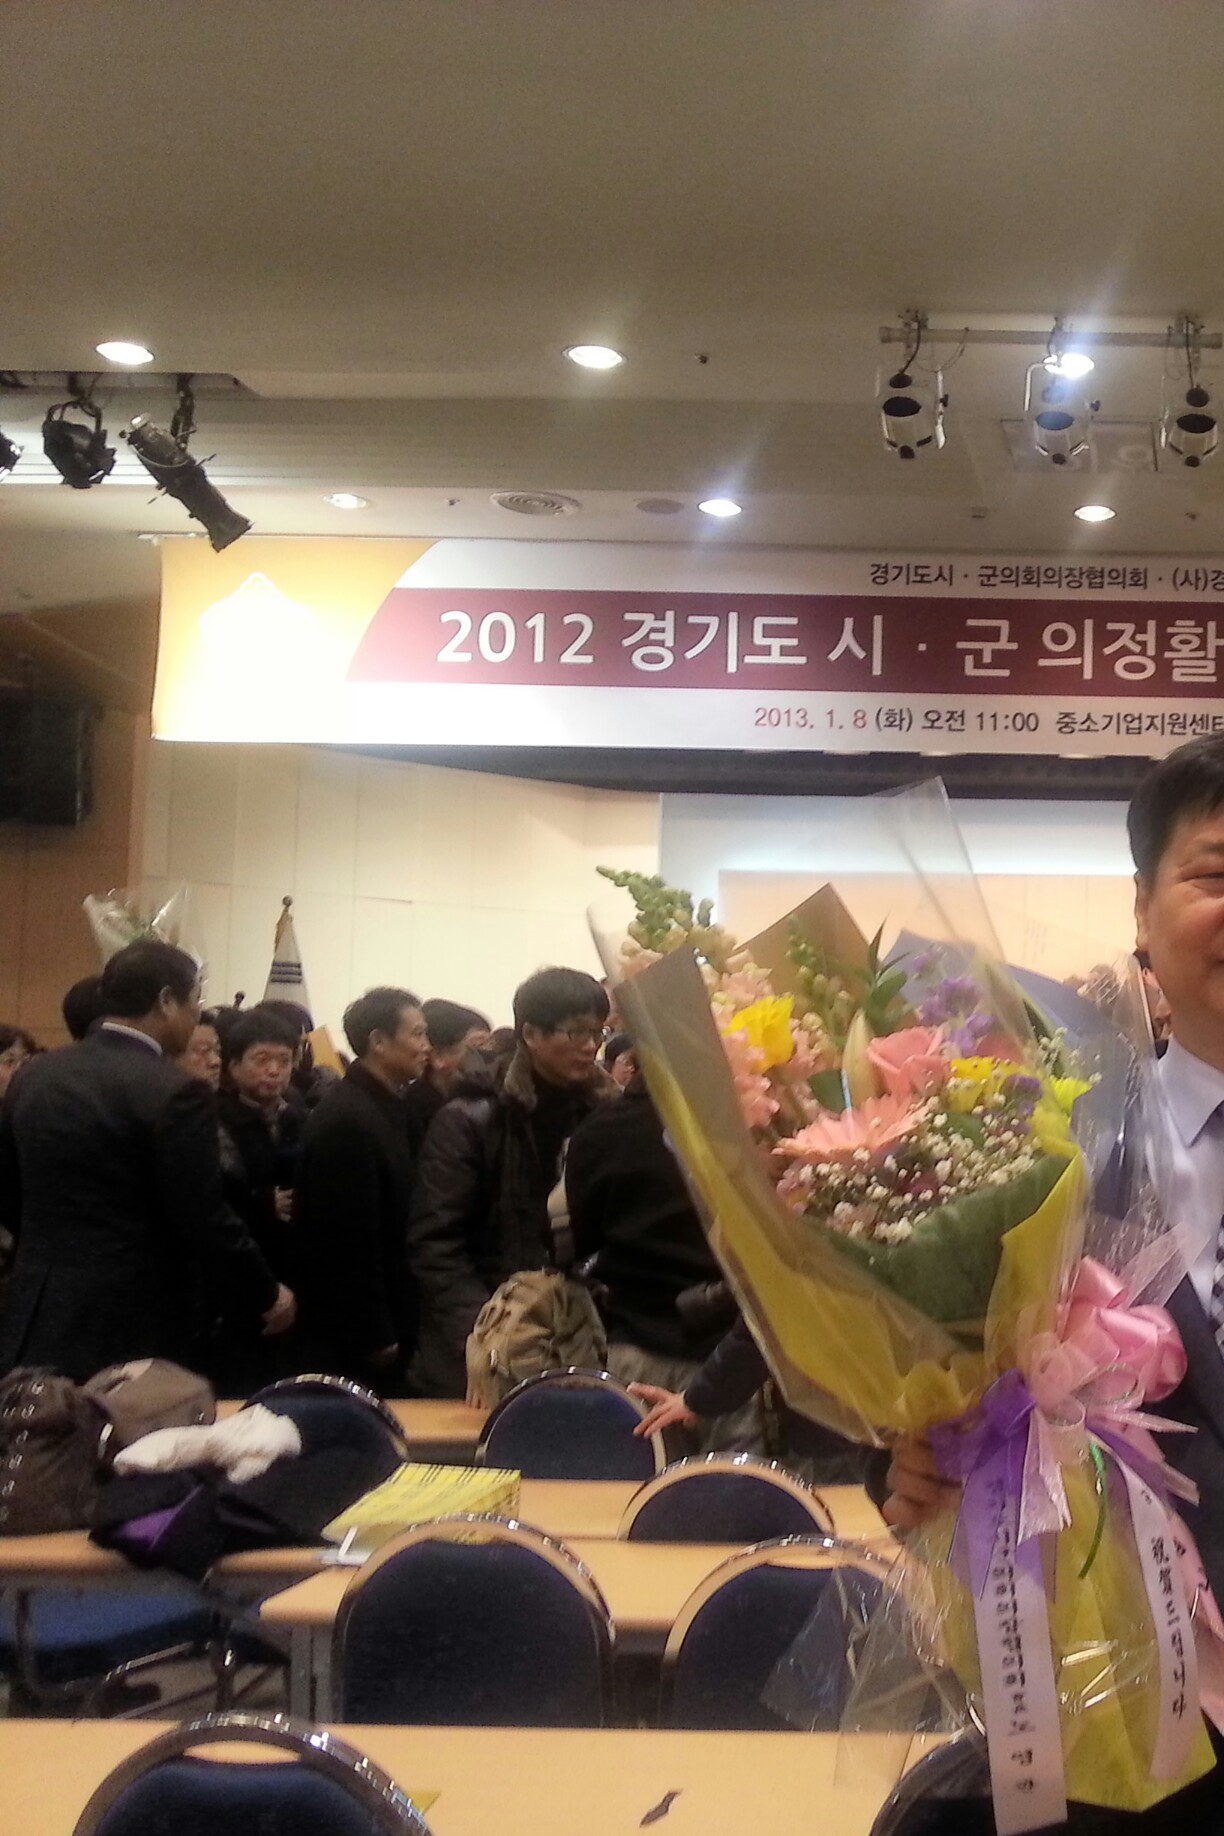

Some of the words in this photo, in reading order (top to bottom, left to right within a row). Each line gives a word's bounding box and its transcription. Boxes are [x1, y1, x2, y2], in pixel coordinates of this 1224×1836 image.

[871, 563, 953, 586] 경기도시
[978, 565, 1148, 590] 군의회의장협의회
[436, 609, 595, 664] 2012
[621, 610, 808, 674] 경기도
[826, 614, 883, 676] 시
[955, 618, 1019, 678] 군
[921, 709, 966, 732] 오전
[976, 711, 1040, 732] 11:00
